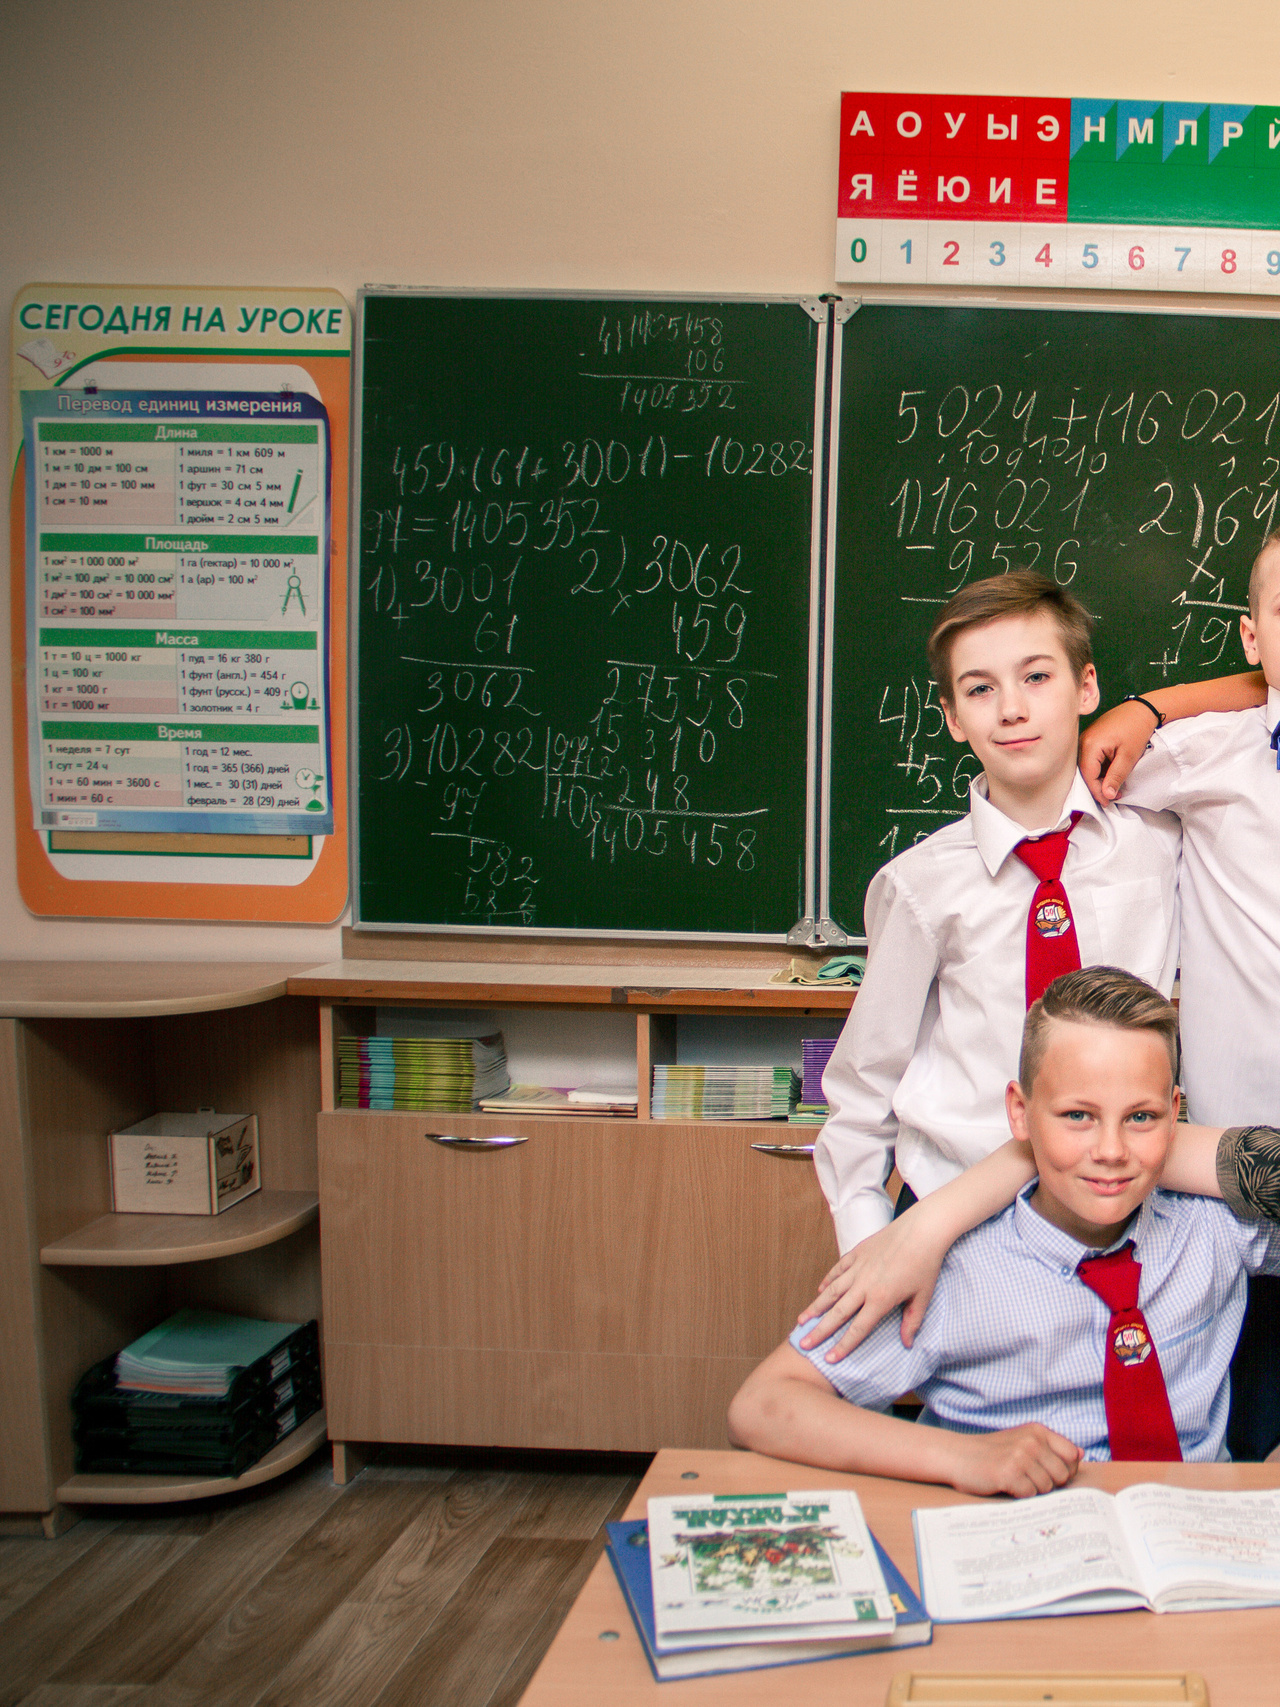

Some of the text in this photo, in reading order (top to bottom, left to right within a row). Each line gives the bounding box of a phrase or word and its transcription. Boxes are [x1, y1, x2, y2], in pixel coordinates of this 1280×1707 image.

[850, 110, 875, 137] А
[896, 111, 922, 138] О
[944, 112, 966, 139] У
[987, 114, 1018, 141] Ы
[1036, 115, 1060, 142] Э
[1083, 115, 1106, 143] Н
[1127, 117, 1154, 144] М
[1174, 118, 1198, 146] Л
[1222, 120, 1244, 147] Р
[849, 174, 873, 200] Я
[897, 169, 918, 202] Ё
[937, 176, 971, 203] Ю
[989, 177, 1012, 204] И
[1036, 178, 1057, 205] Е
[850, 237, 868, 264] 0
[900, 239, 912, 265] 1
[942, 240, 960, 266] 2
[989, 241, 1006, 266] 3
[1034, 242, 1053, 268] 4
[1082, 243, 1099, 269] 5
[1128, 245, 1145, 271] 6
[1174, 247, 1192, 272] 7
[1220, 248, 1237, 275] 8
[19, 303, 343, 335] СЕГОДНЯ НА УРОКЕ
[685, 347, 725, 376] 106
[58, 395, 302, 416] Перевод единиц измерения
[155, 425, 198, 441] Длина
[80, 447, 101, 456] 1000
[254, 448, 273, 457] 609
[187, 464, 246, 475] аршин 71
[187, 481, 234, 491] фут 30
[186, 500, 222, 508] вершок
[145, 537, 209, 552] Площадь
[200, 558, 280, 569] (гектар) 000
[228, 575, 244, 584] 100
[474, 612, 518, 654] 61
[672, 601, 747, 662] 459
[155, 632, 199, 646] Масса
[189, 653, 262, 664] пуд 16 380
[189, 670, 213, 681] фунт
[261, 671, 278, 680] 454
[189, 687, 212, 697] фунт
[264, 687, 281, 696] 409
[418, 671, 542, 716] 3062
[157, 725, 203, 740] Время
[56, 746, 130, 756] неделя сут
[192, 748, 209, 757] год
[86, 761, 99, 770] 24
[222, 763, 290, 774] 365 (366) дней
[126, 778, 150, 787] 3600
[187, 796, 300, 807] февраль (29) дней
